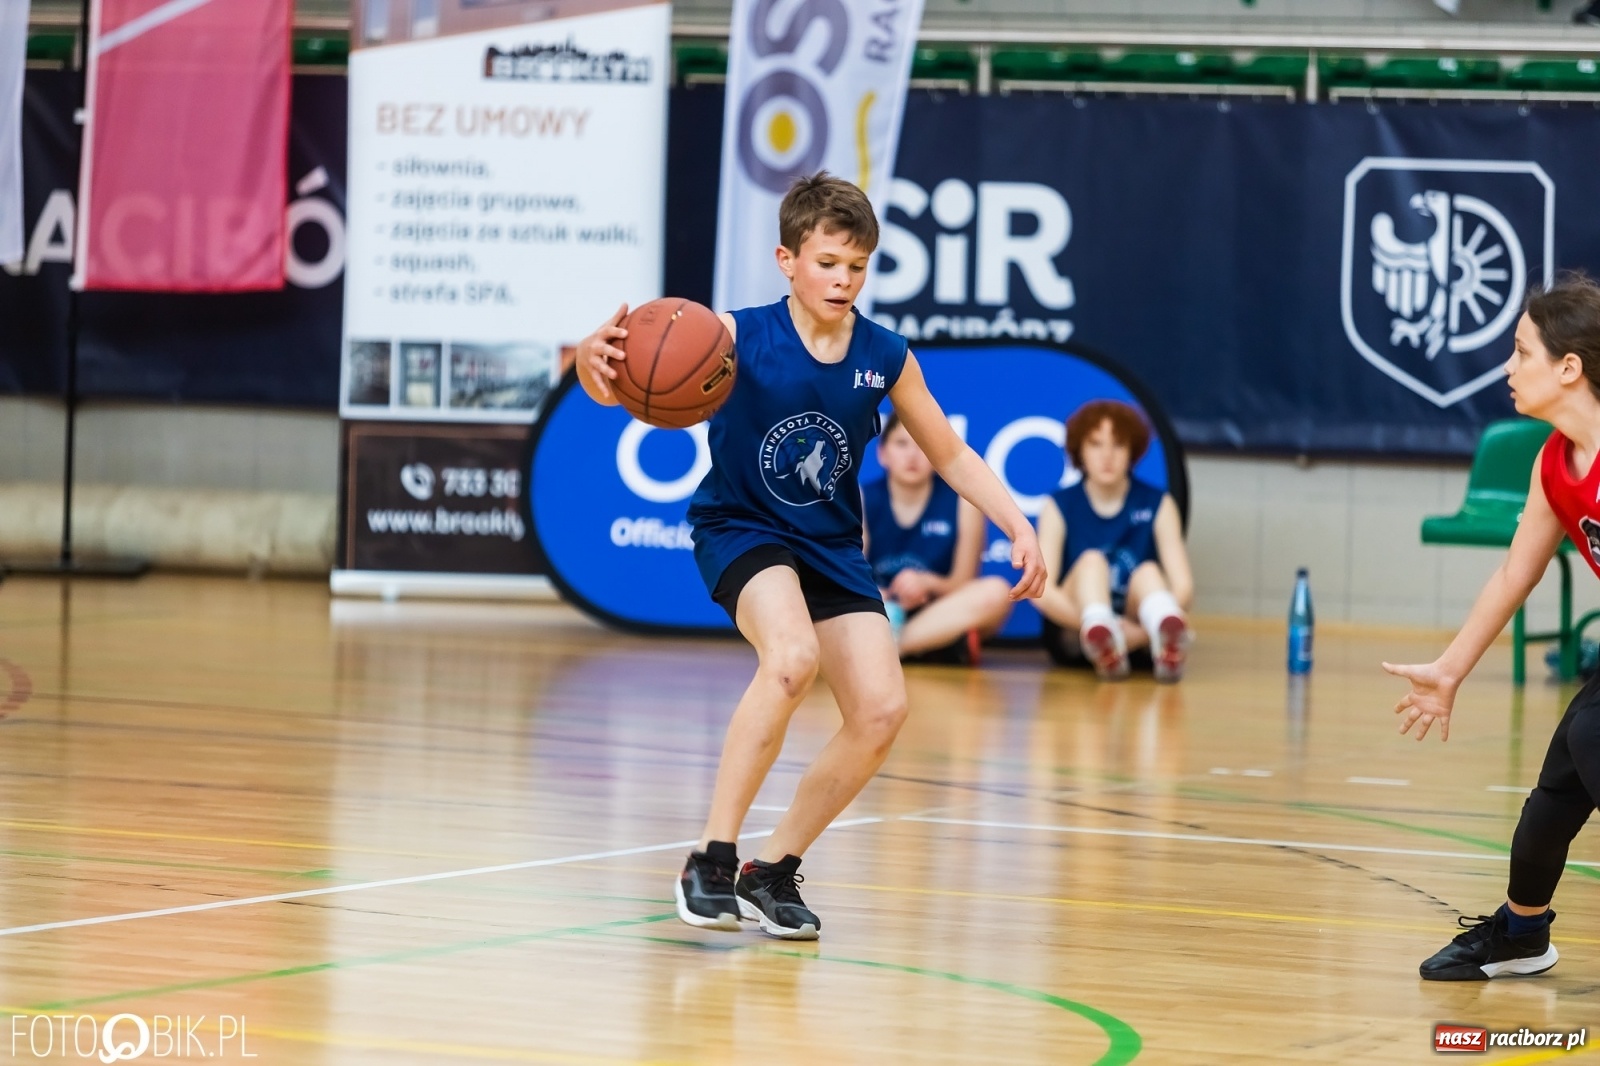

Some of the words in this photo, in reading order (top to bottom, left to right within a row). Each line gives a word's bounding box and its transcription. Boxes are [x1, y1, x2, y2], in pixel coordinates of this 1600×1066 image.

[863, 0, 901, 64] RA
[376, 103, 445, 136] BEZ
[455, 104, 592, 138] UMOWY
[764, 416, 809, 469] MINNESOTA
